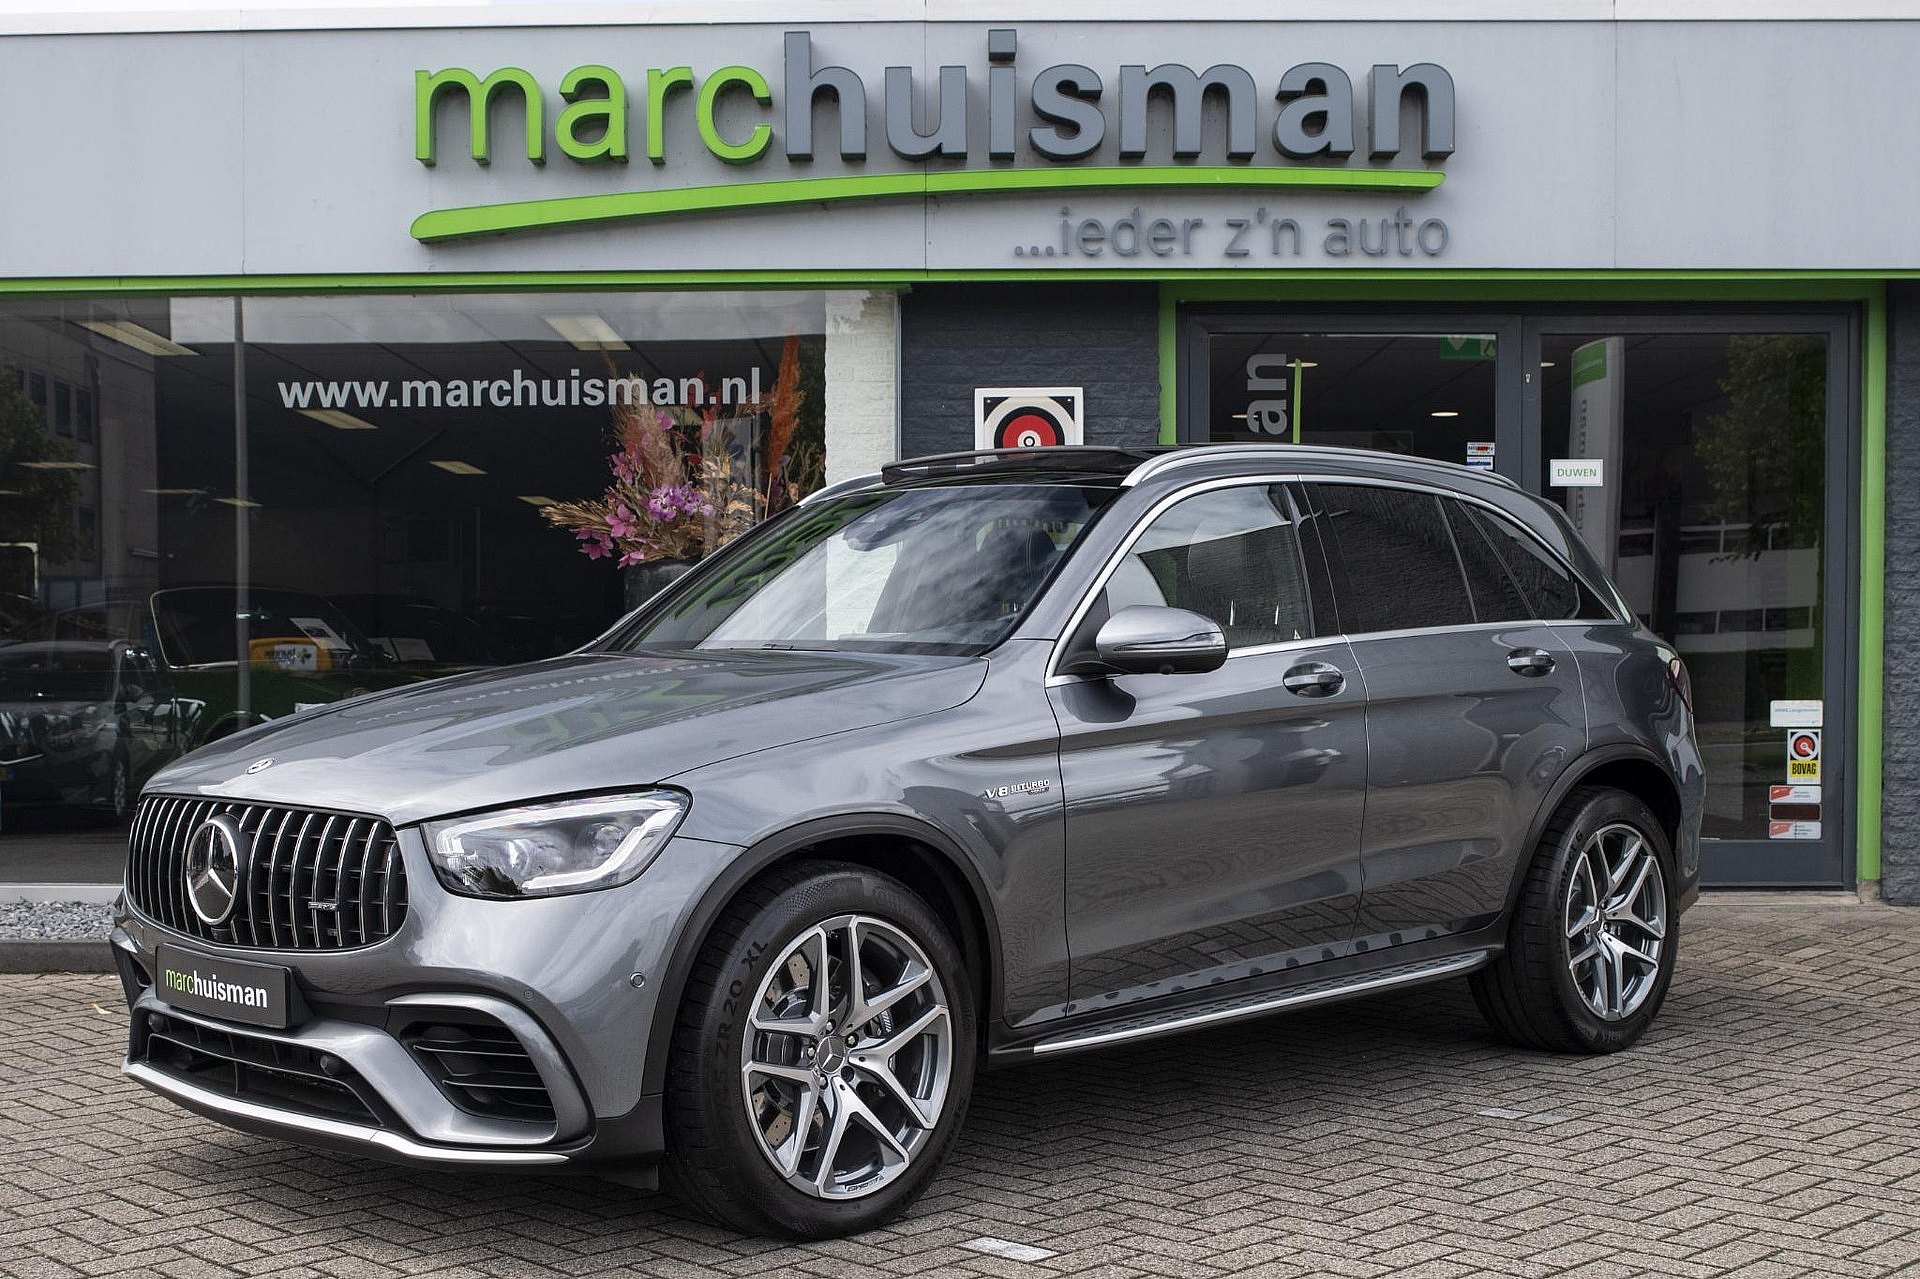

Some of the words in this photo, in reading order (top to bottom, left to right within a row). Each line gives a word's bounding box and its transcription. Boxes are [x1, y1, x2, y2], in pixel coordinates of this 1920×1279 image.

[415, 29, 1455, 166] marchuisman
[1223, 207, 1300, 257] z'n
[1324, 206, 1449, 257] auto
[278, 367, 761, 409] www.marchuisman.nl
[1556, 467, 1598, 479] DUWEN
[1791, 763, 1817, 775] BOVAG
[985, 785, 1009, 798] V8
[165, 968, 268, 1008] marchuisman
